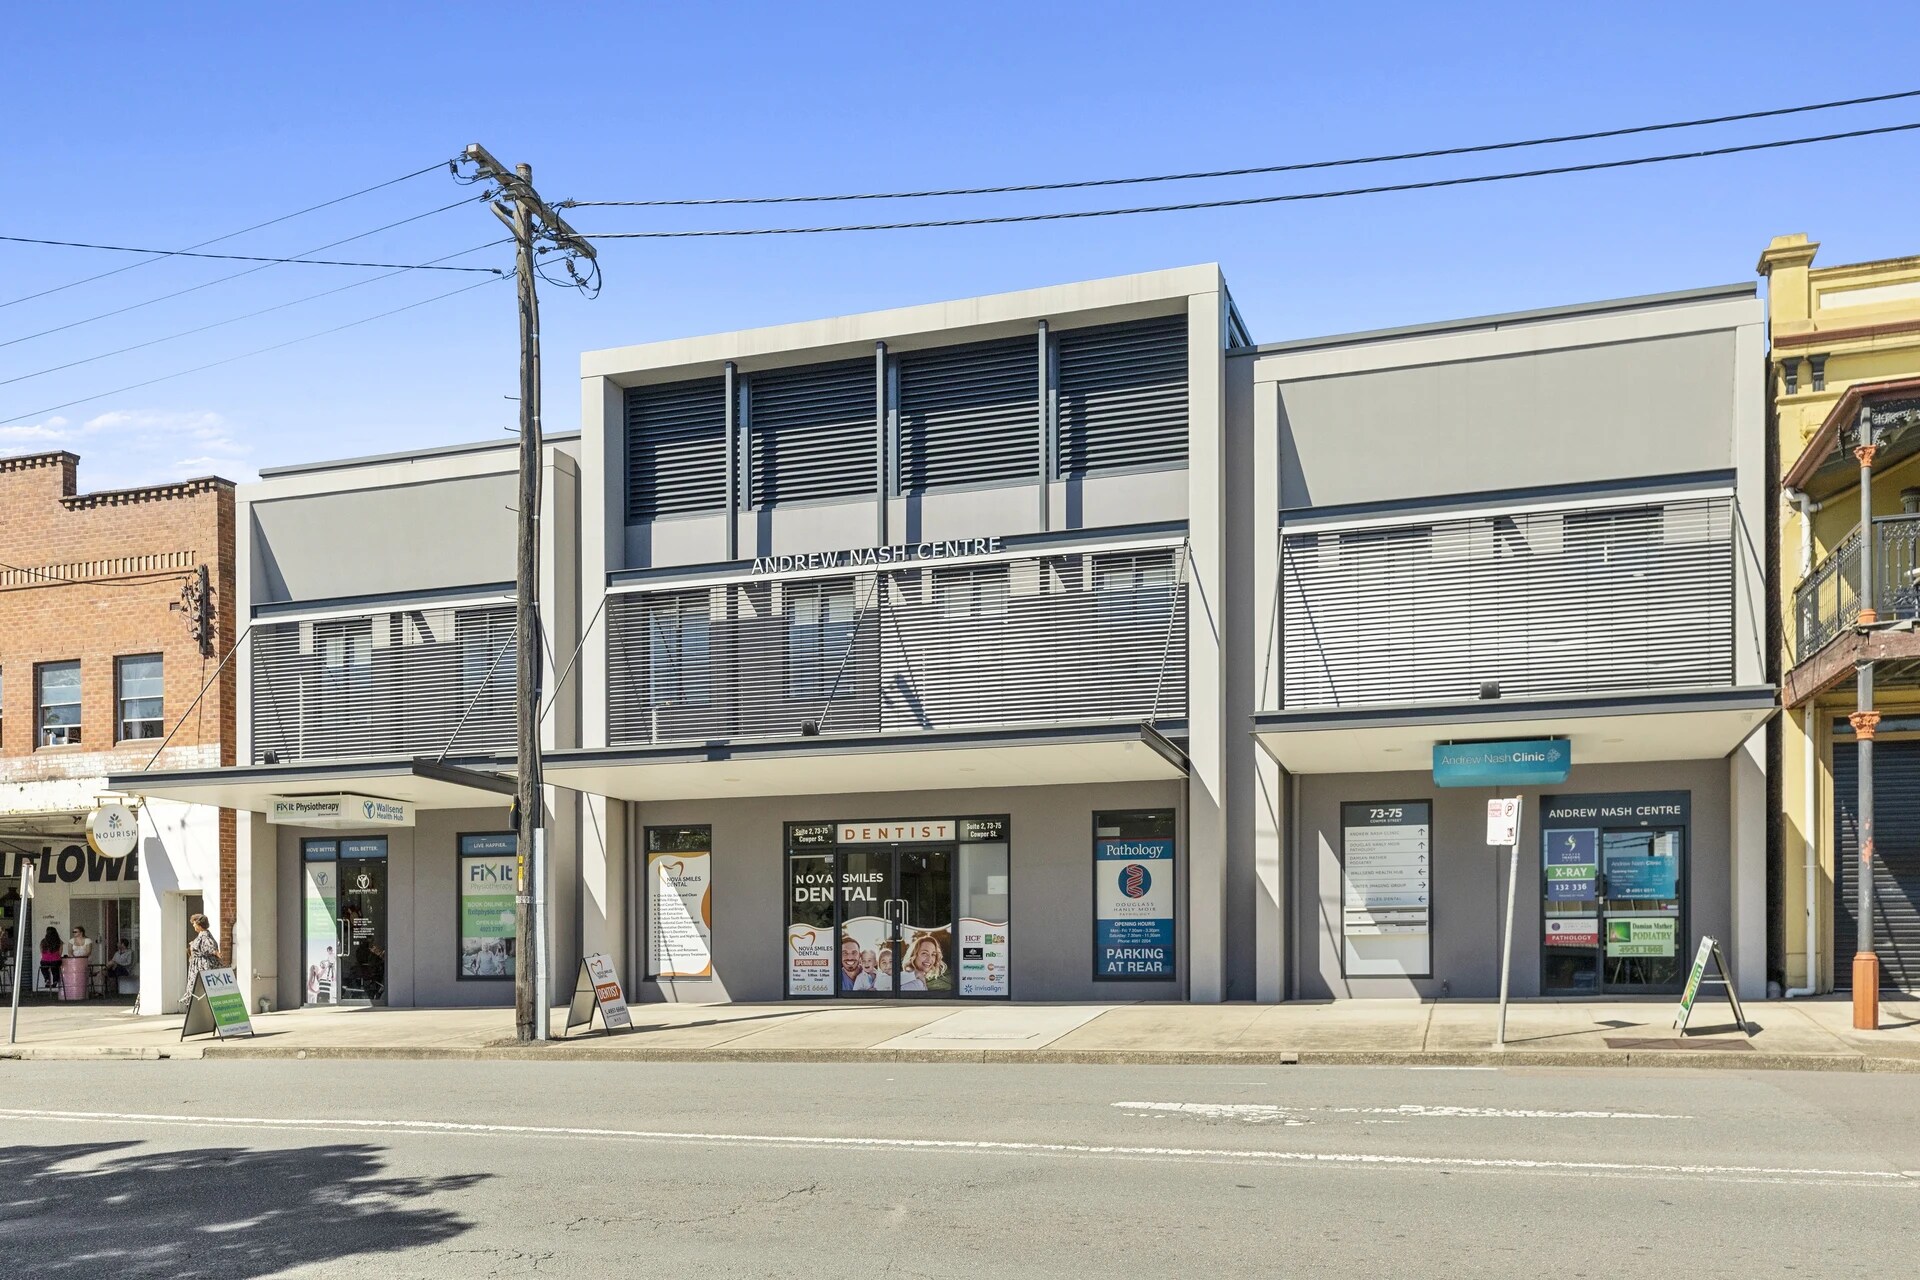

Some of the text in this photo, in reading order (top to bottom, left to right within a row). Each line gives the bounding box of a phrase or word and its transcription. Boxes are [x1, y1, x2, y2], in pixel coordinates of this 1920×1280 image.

[751, 537, 1001, 575] ANDREW NASH CENTRE
[1442, 755, 1481, 765] Andrew
[296, 802, 340, 812] Physiotherapy
[376, 802, 403, 814] Wallsend
[1548, 806, 1680, 818] ANDREW NASH CENTRE
[376, 812, 392, 820] Health
[1370, 808, 1402, 818] 73-75
[96, 830, 137, 840] NOURISH
[844, 826, 946, 840] DENTIST
[970, 830, 990, 838] Cowper
[799, 836, 816, 844] Cowper
[1106, 844, 1163, 858] Pathology
[500, 864, 512, 880] It
[1555, 868, 1587, 877] X-RAY
[796, 873, 884, 884] NOVA SMILES
[1632, 932, 1672, 940] PODIATRY
[1106, 948, 1164, 959] PARKING
[1108, 962, 1162, 972] AT REAR
[598, 985, 618, 1000] DENTIST
